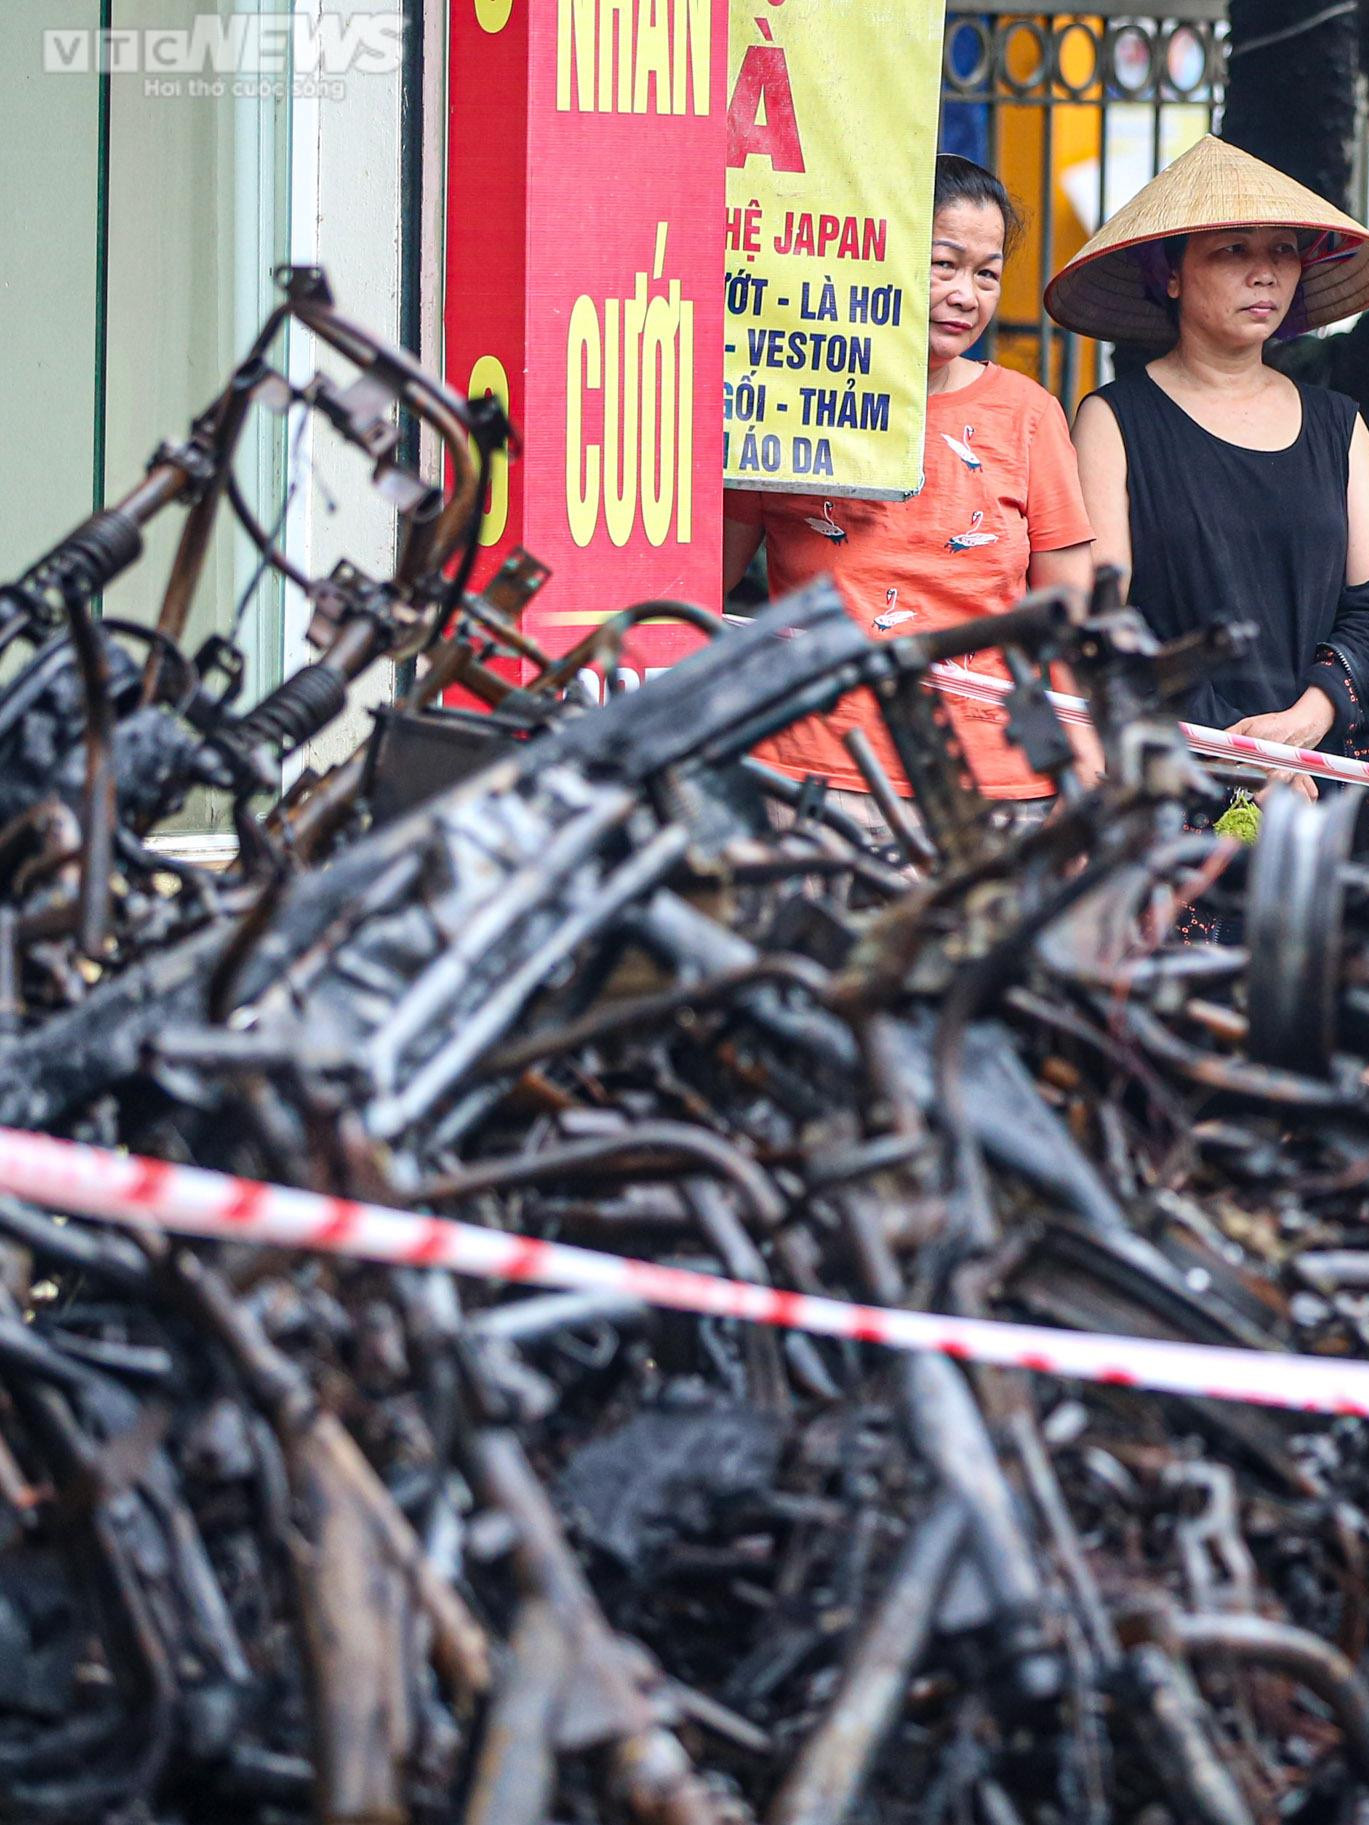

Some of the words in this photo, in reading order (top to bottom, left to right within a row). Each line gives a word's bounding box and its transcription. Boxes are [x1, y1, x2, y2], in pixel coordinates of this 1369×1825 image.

[774, 211, 887, 262] JAPAN
[725, 268, 768, 317] ỚT
[800, 275, 838, 322] LÀ
[850, 283, 902, 326] HƠI
[747, 328, 872, 375] VESTON
[565, 221, 694, 548] CƯỚI
[799, 377, 891, 432] THẢM
[739, 425, 781, 472] ÁO
[792, 436, 834, 476] DA
